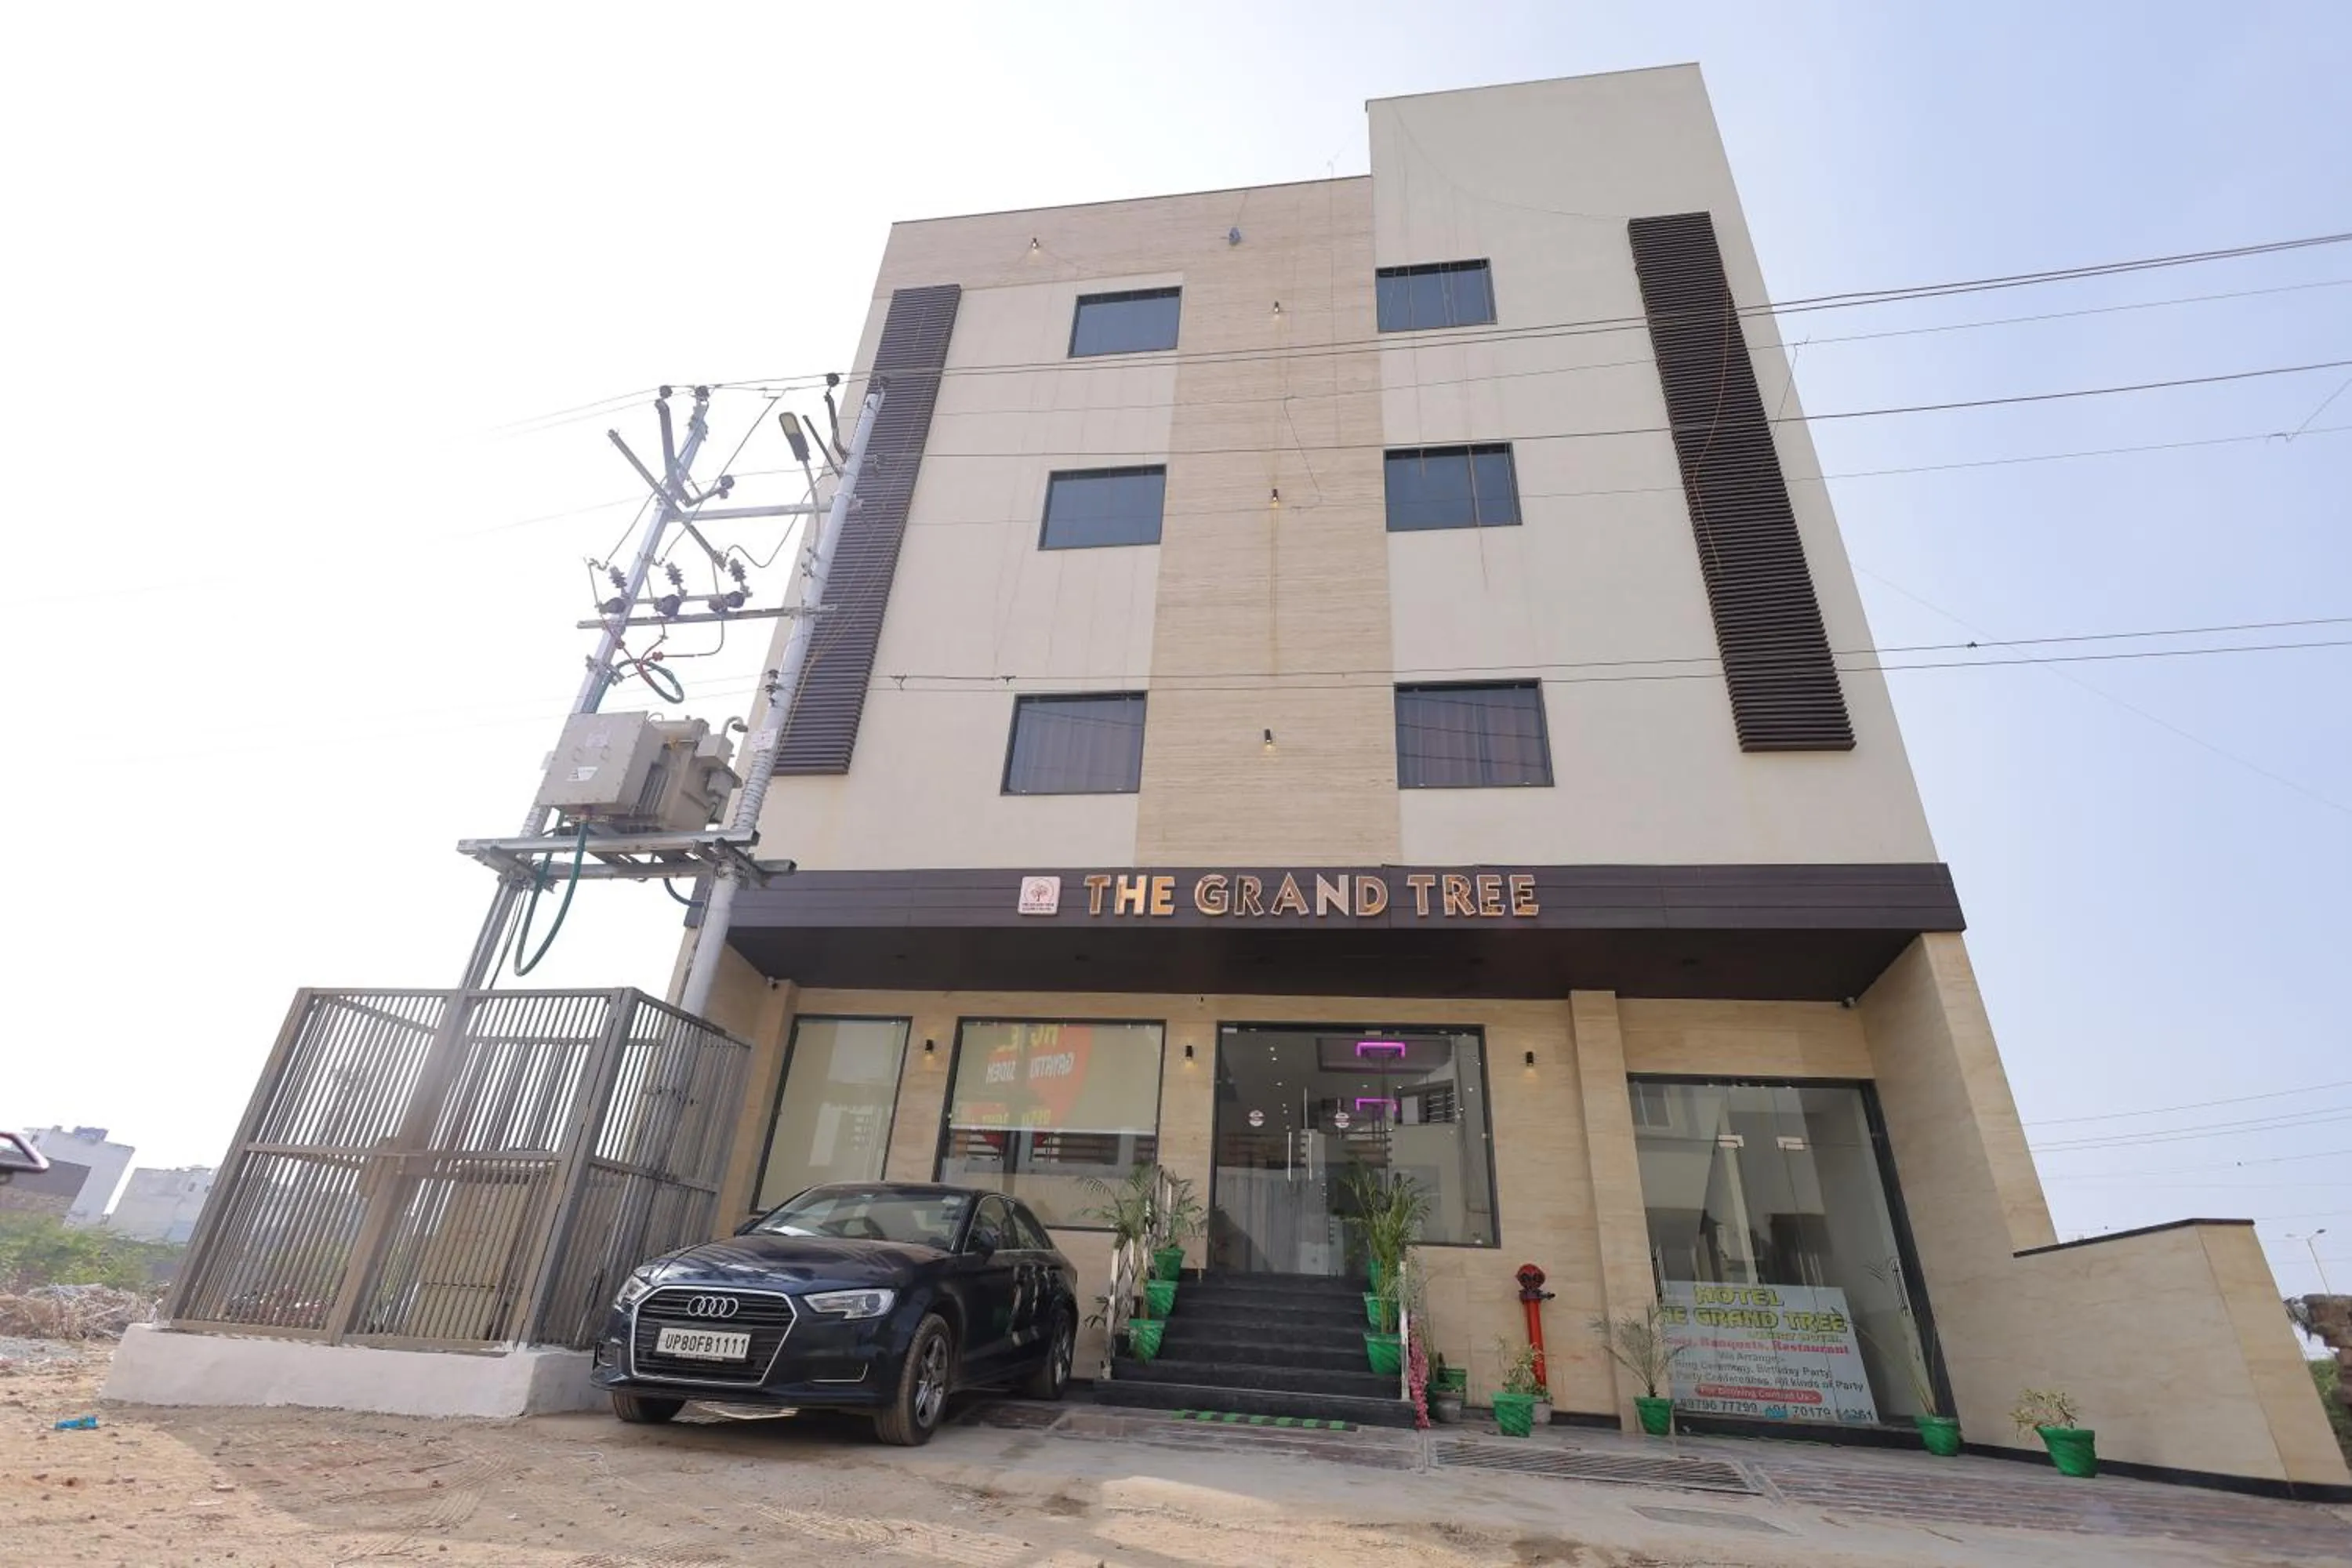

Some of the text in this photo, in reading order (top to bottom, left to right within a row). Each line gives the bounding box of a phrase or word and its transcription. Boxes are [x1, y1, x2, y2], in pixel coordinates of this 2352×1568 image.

[1083, 872, 1540, 917] THE GRAND TREE
[1693, 1285, 1784, 1307] HOTEL
[1693, 1307, 1779, 1330] GRAND
[1784, 1312, 1848, 1334] TREE
[665, 1334, 746, 1355] UP80FB1111
[1835, 1380, 1864, 1393] Party
